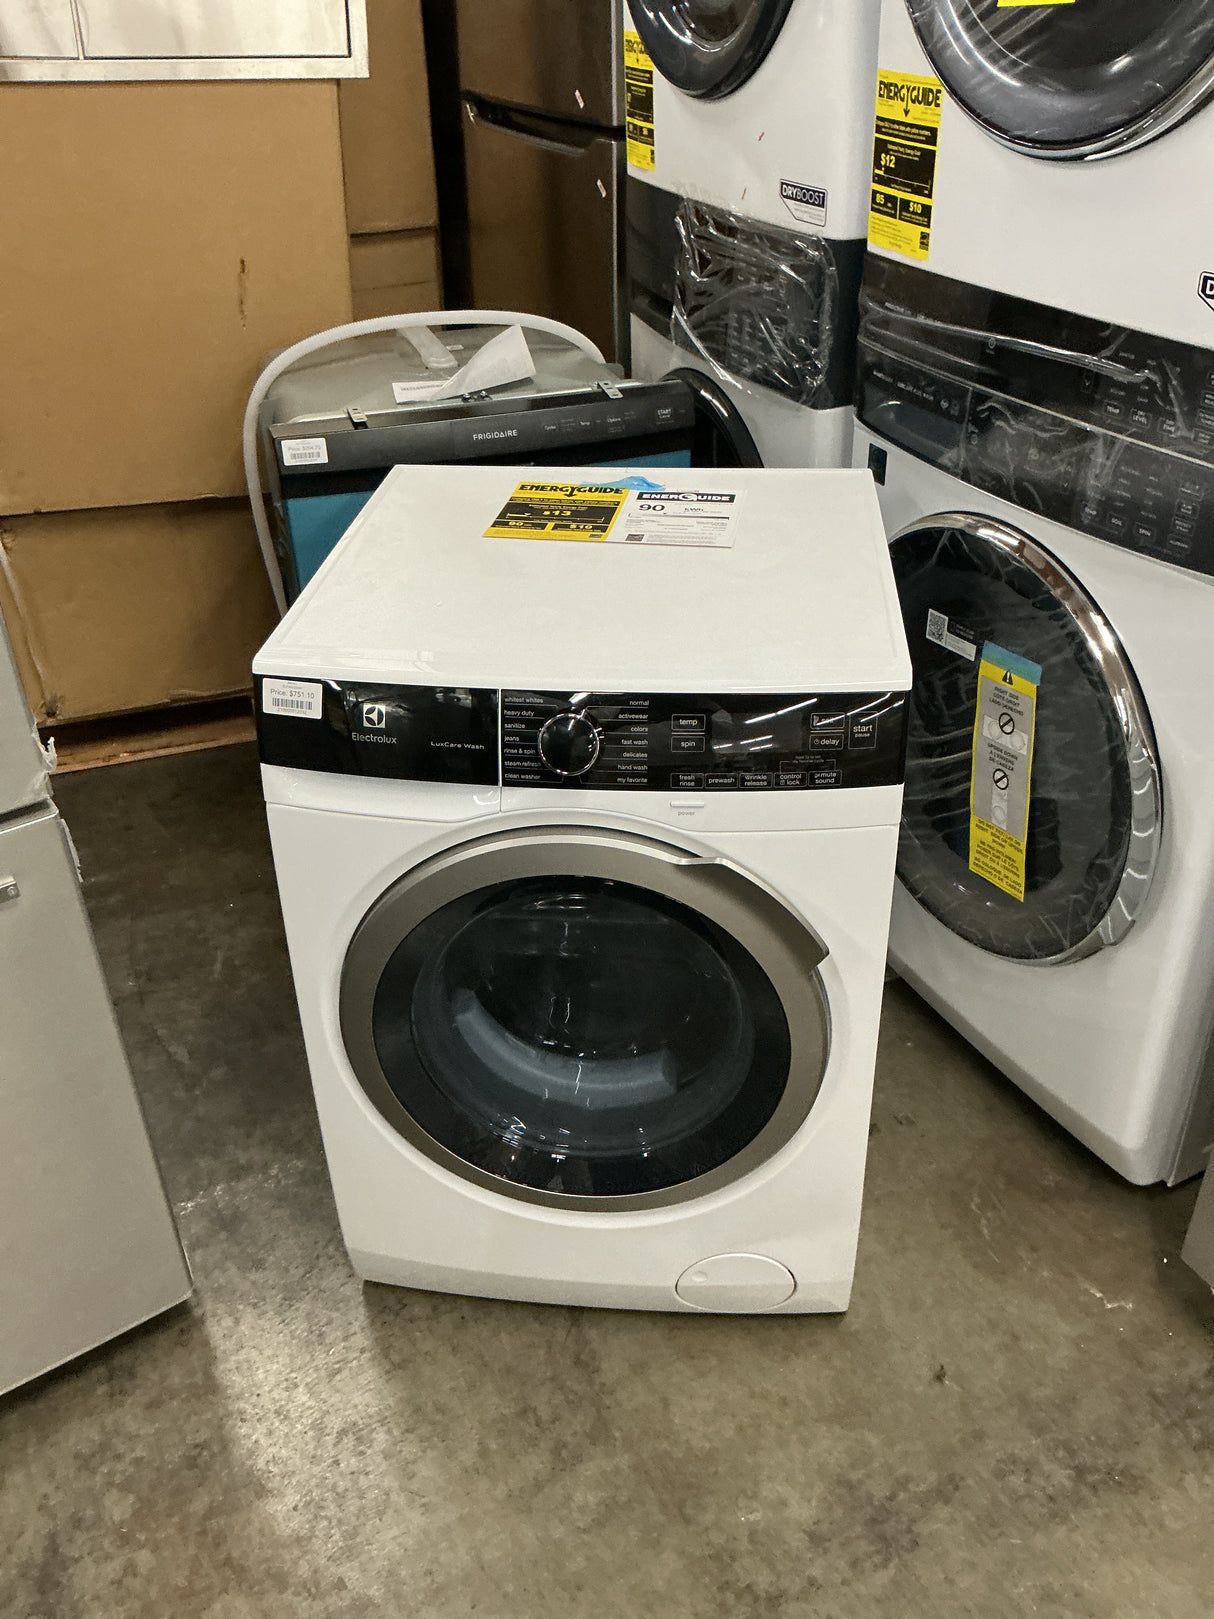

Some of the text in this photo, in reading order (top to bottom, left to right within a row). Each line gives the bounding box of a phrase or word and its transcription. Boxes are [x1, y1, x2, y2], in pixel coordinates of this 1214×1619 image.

[878, 80, 942, 108] ENERGYGUIDE
[880, 153, 896, 168] $12
[781, 184, 825, 206] DRYBOOST
[909, 202, 922, 214] $10
[473, 429, 518, 441] FRIGIDAIRE
[518, 484, 625, 495] ENERGYGUIDE
[641, 493, 731, 502] ENERGUIDE
[639, 503, 666, 512] 90
[289, 690, 315, 699] $751.10
[679, 719, 698, 727] temp
[351, 731, 397, 744] Electrolux
[820, 738, 840, 746] delay
[430, 741, 462, 749] LuxCare
[680, 740, 696, 748] spin
[708, 777, 735, 785] prewash
